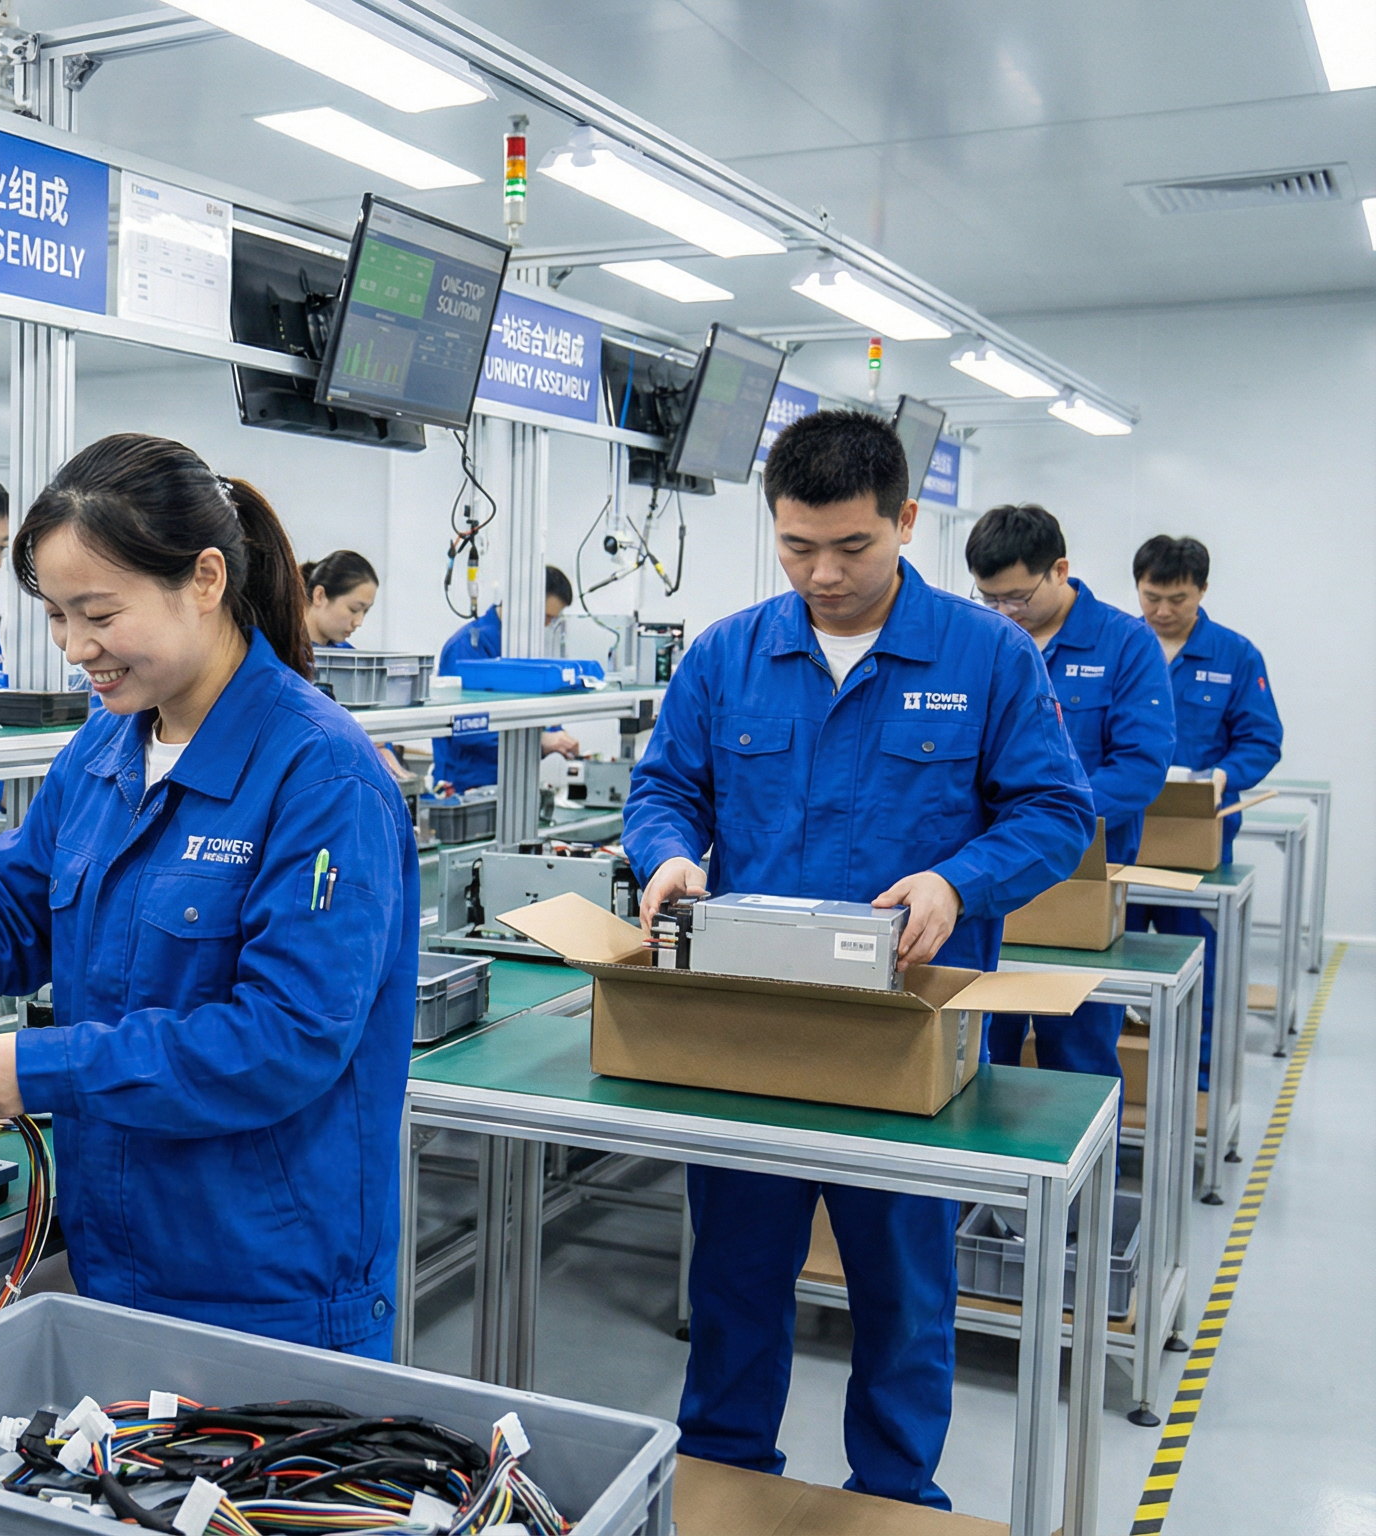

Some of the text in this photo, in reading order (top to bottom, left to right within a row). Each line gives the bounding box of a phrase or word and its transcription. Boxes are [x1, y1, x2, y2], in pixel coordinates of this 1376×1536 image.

[484, 355, 591, 402] URNKEY ASSEMBLY
[924, 692, 968, 704] TOWER
[206, 838, 254, 855] TOWER
